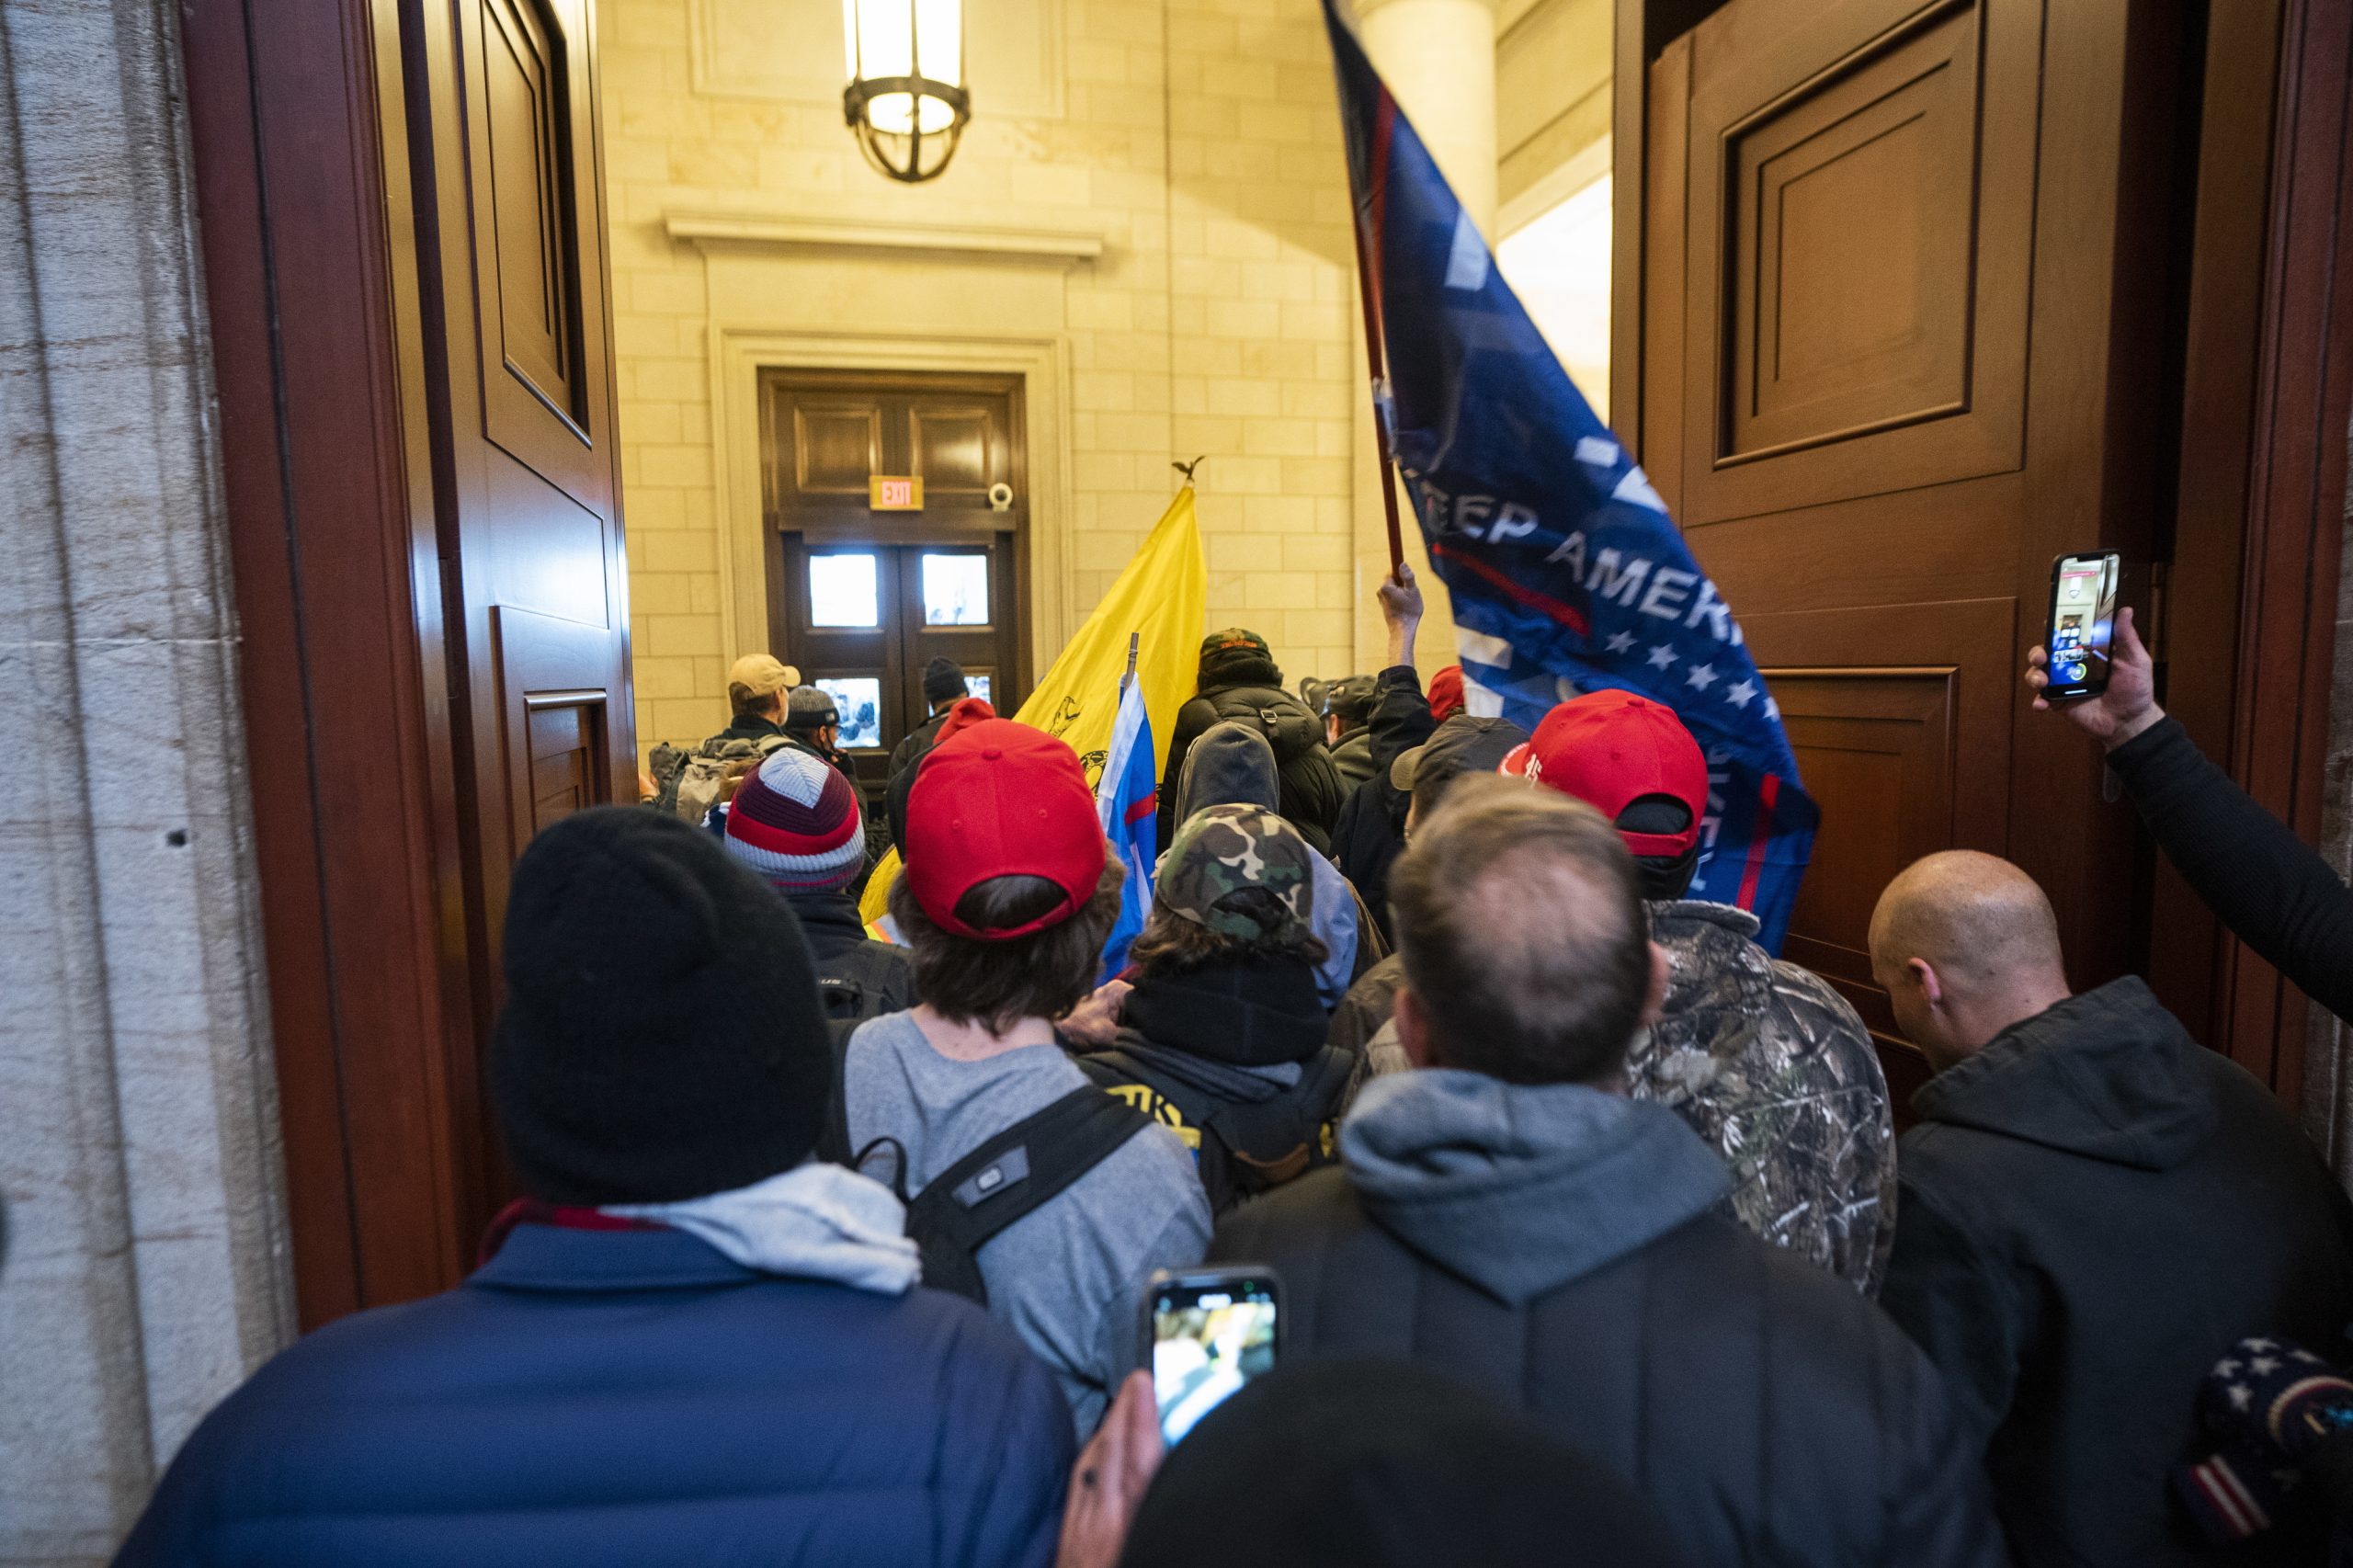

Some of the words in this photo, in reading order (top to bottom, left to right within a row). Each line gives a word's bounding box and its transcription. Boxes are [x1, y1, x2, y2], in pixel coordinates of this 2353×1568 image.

[881, 481, 912, 506] EXIT
[1419, 479, 1539, 544] EEP
[1543, 529, 1744, 647] AMER
